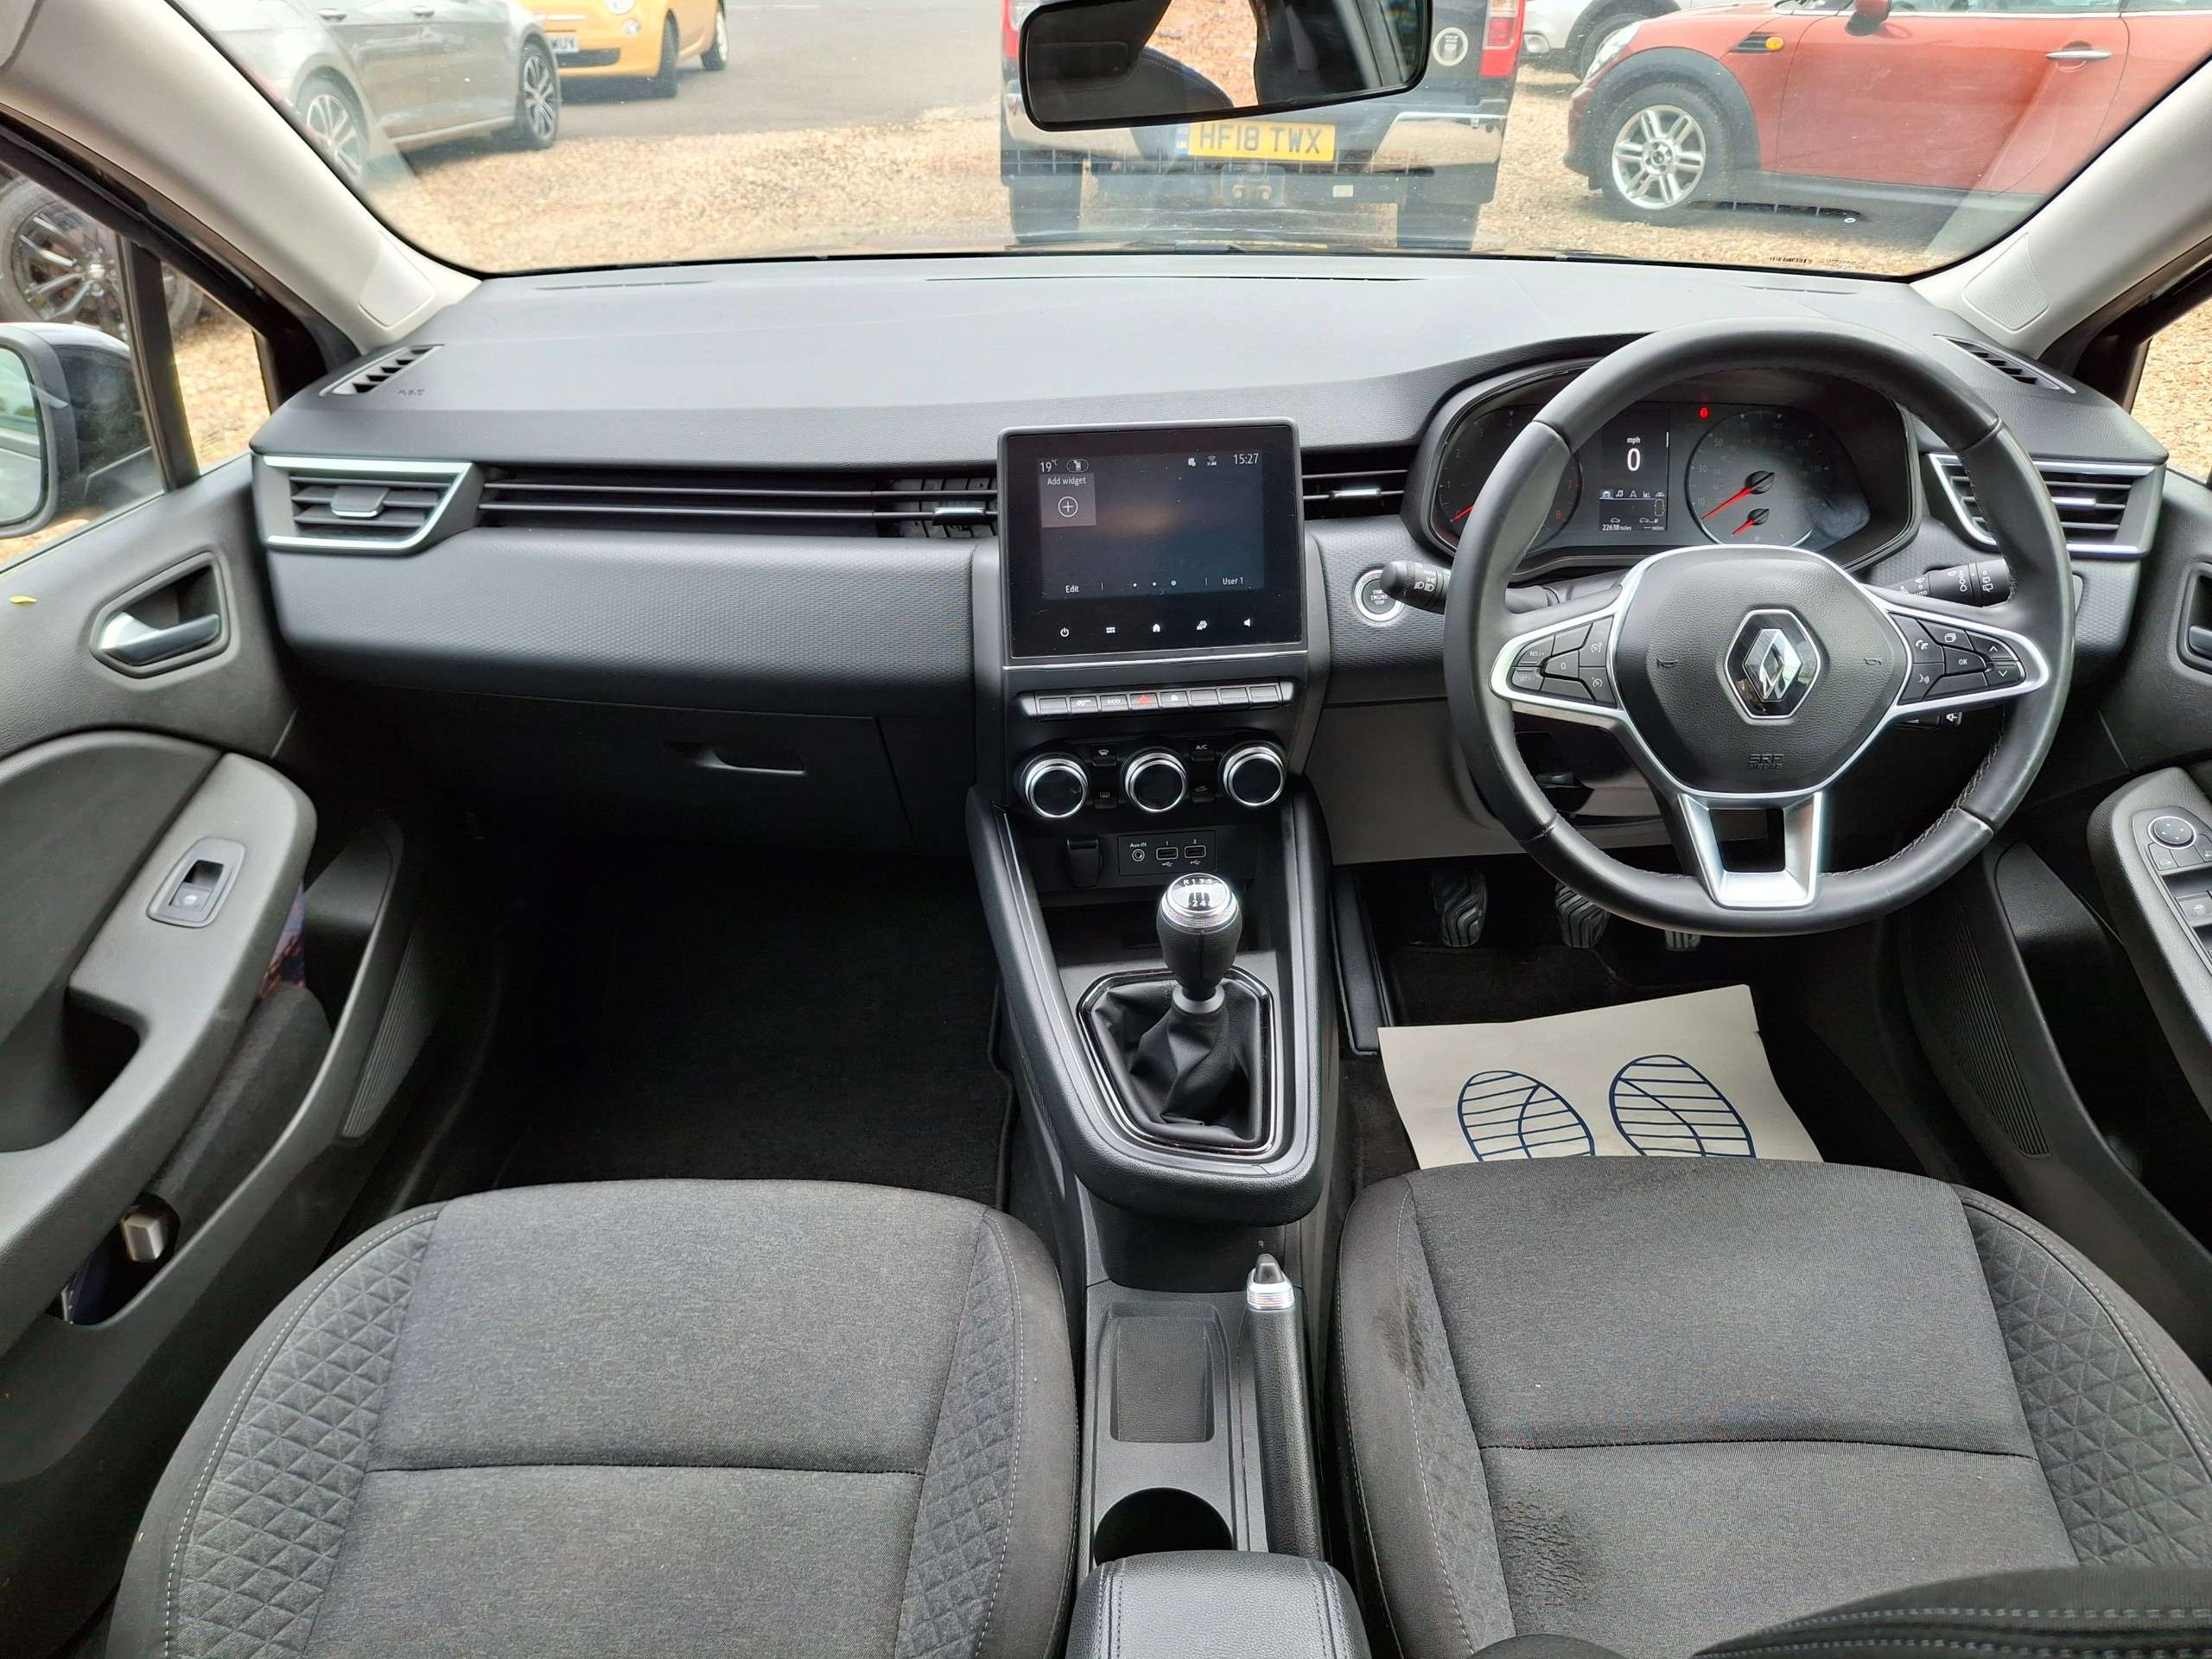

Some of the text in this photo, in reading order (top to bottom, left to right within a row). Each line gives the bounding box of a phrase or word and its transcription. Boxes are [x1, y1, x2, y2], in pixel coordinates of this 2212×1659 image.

[1198, 123, 1322, 154] HF18 TWX
[1626, 436, 1641, 445] mph
[1233, 453, 1259, 465] 15:27
[1627, 448, 1641, 472] 0
[1047, 476, 1087, 486] Add widget
[1065, 584, 1079, 594] Edit
[1958, 658, 1968, 666] OK
